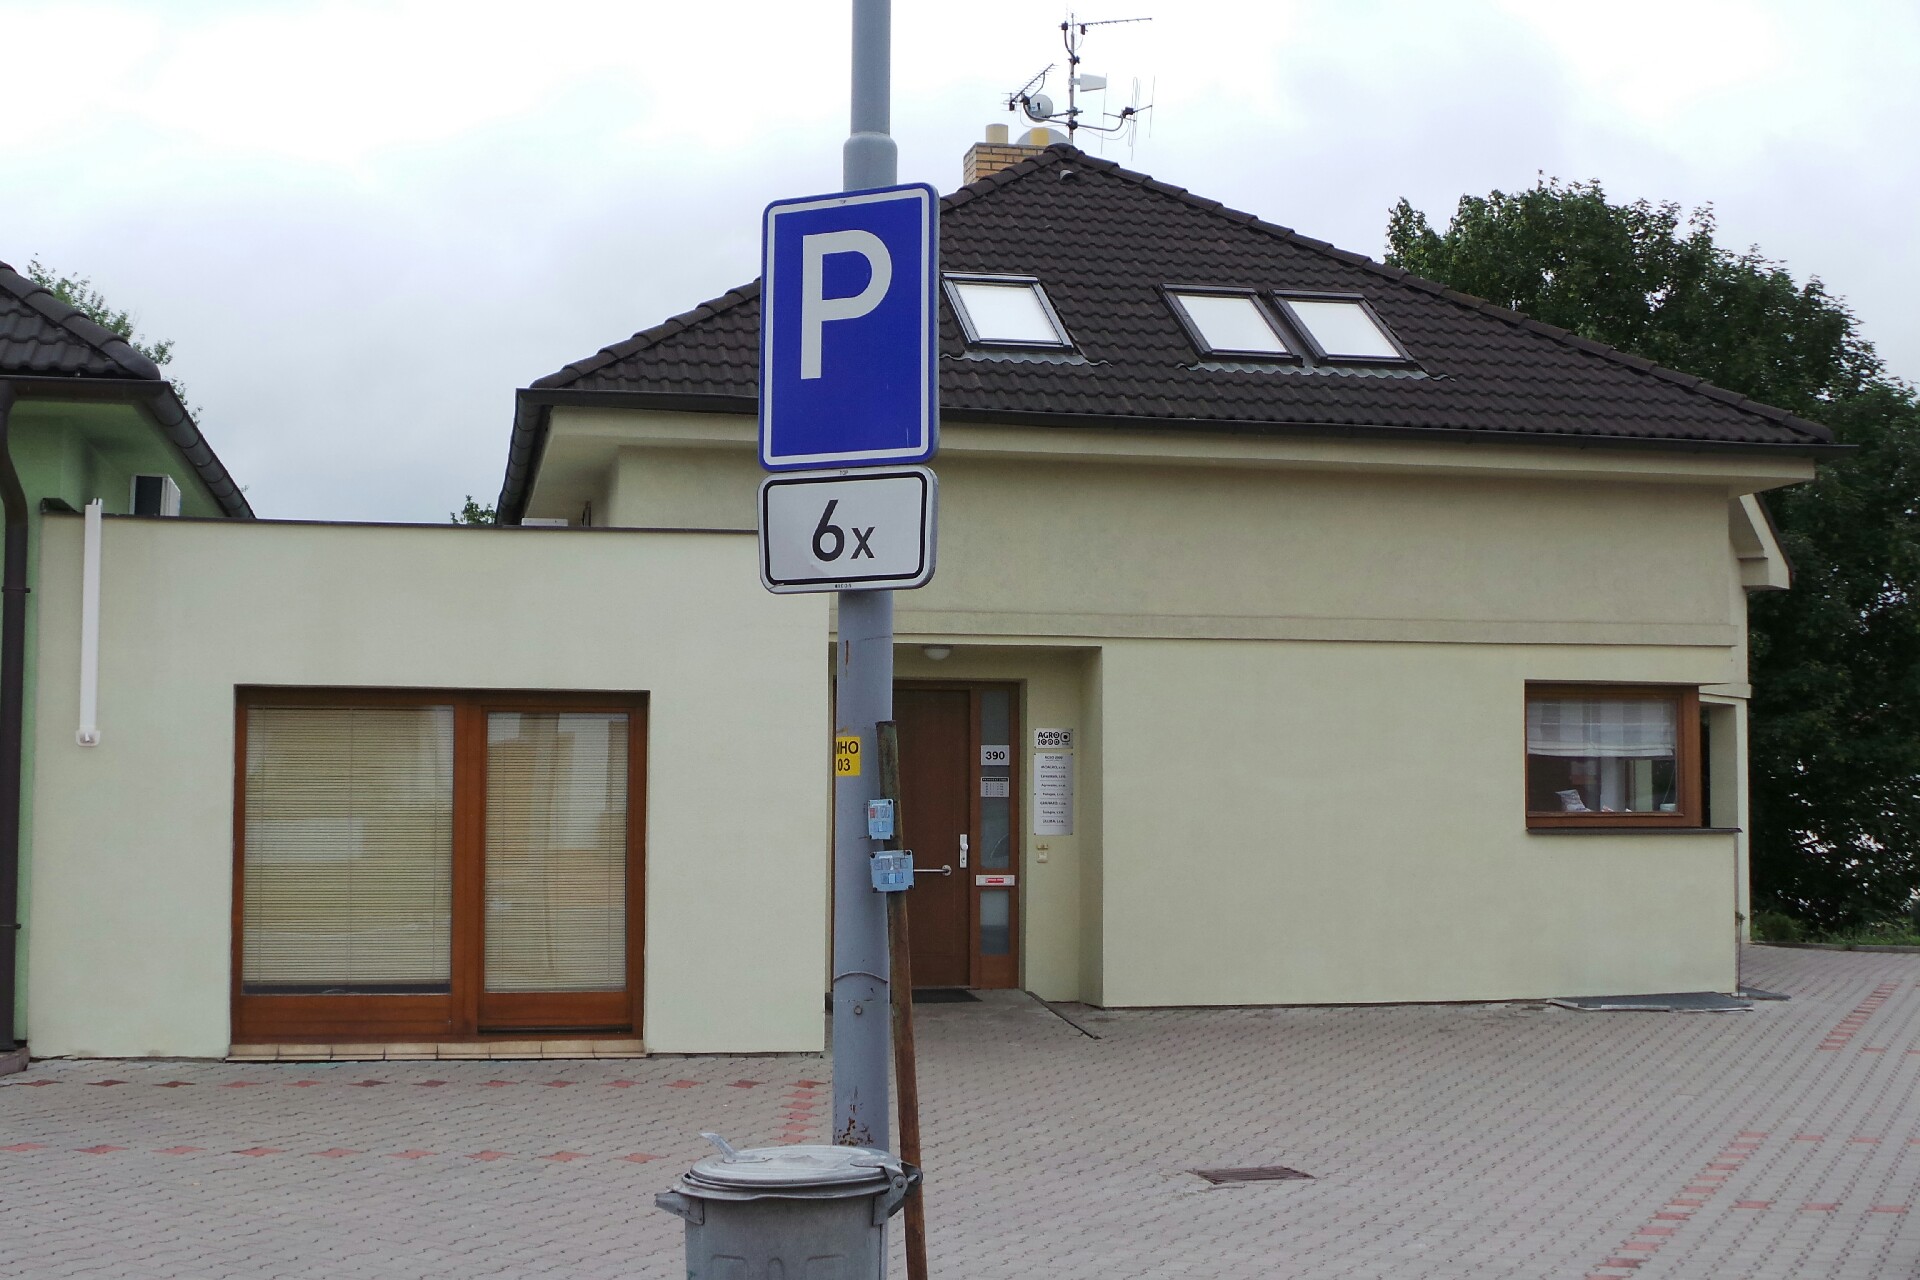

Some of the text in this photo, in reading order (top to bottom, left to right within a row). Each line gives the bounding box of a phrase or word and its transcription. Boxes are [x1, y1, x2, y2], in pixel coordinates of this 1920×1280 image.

[801, 229, 892, 380] P
[1037, 731, 1060, 739] AGRO
[1037, 738, 1060, 746] 2000
[986, 751, 1005, 760] 390
